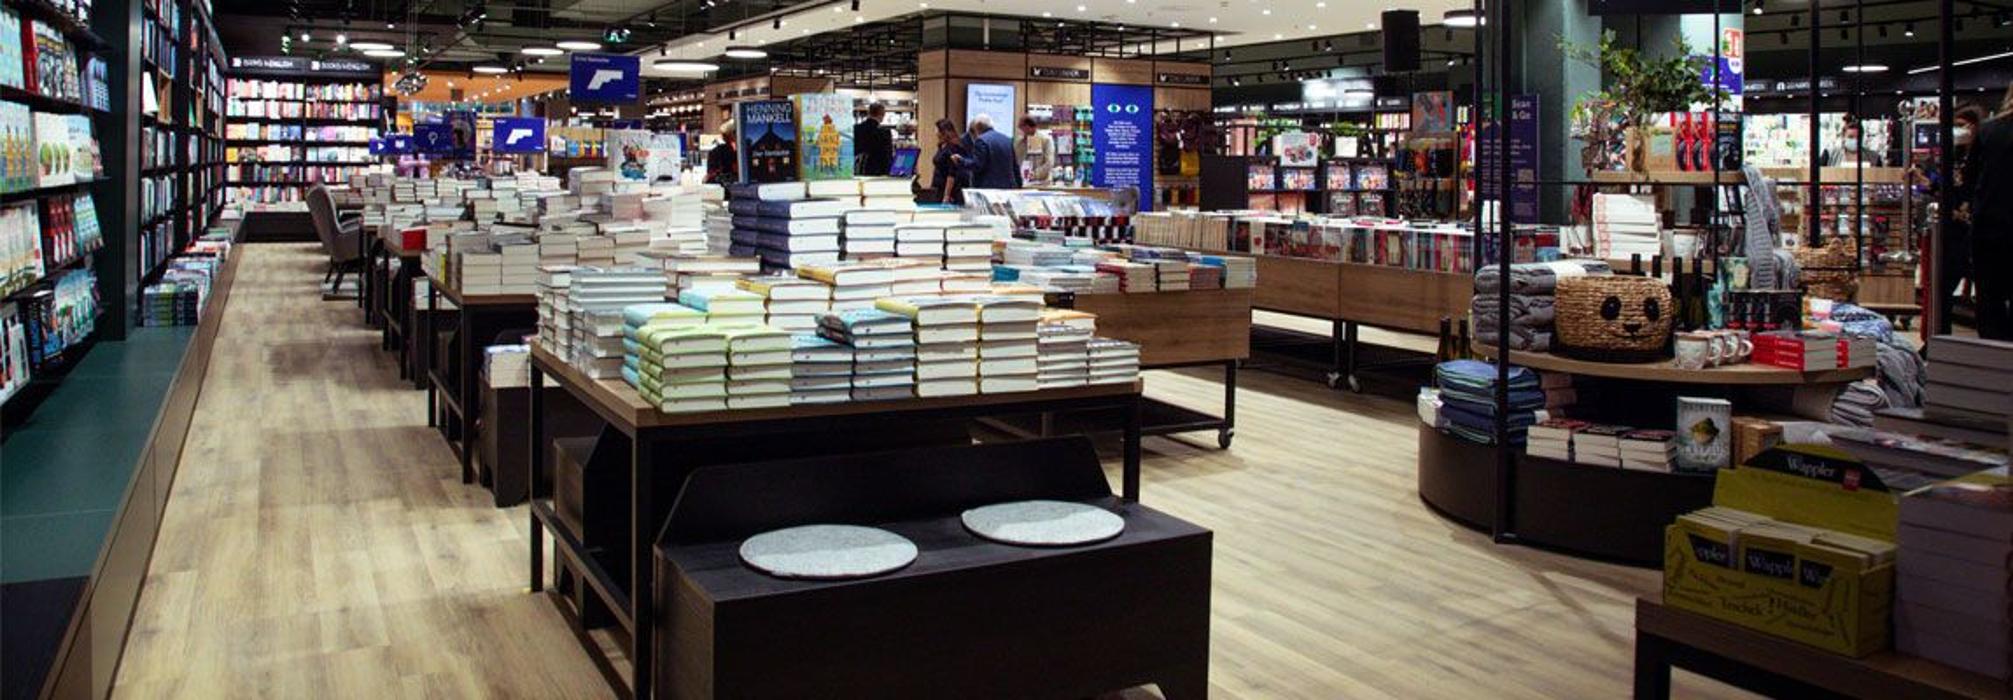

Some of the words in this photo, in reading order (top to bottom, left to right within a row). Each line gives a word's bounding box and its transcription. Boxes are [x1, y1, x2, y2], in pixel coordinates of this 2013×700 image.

[747, 103, 791, 113] HENNING
[1512, 98, 1530, 109] Scan
[747, 113, 791, 124] MANKELL
[1787, 455, 1836, 478] Wappler
[1697, 546, 1726, 562] ppler
